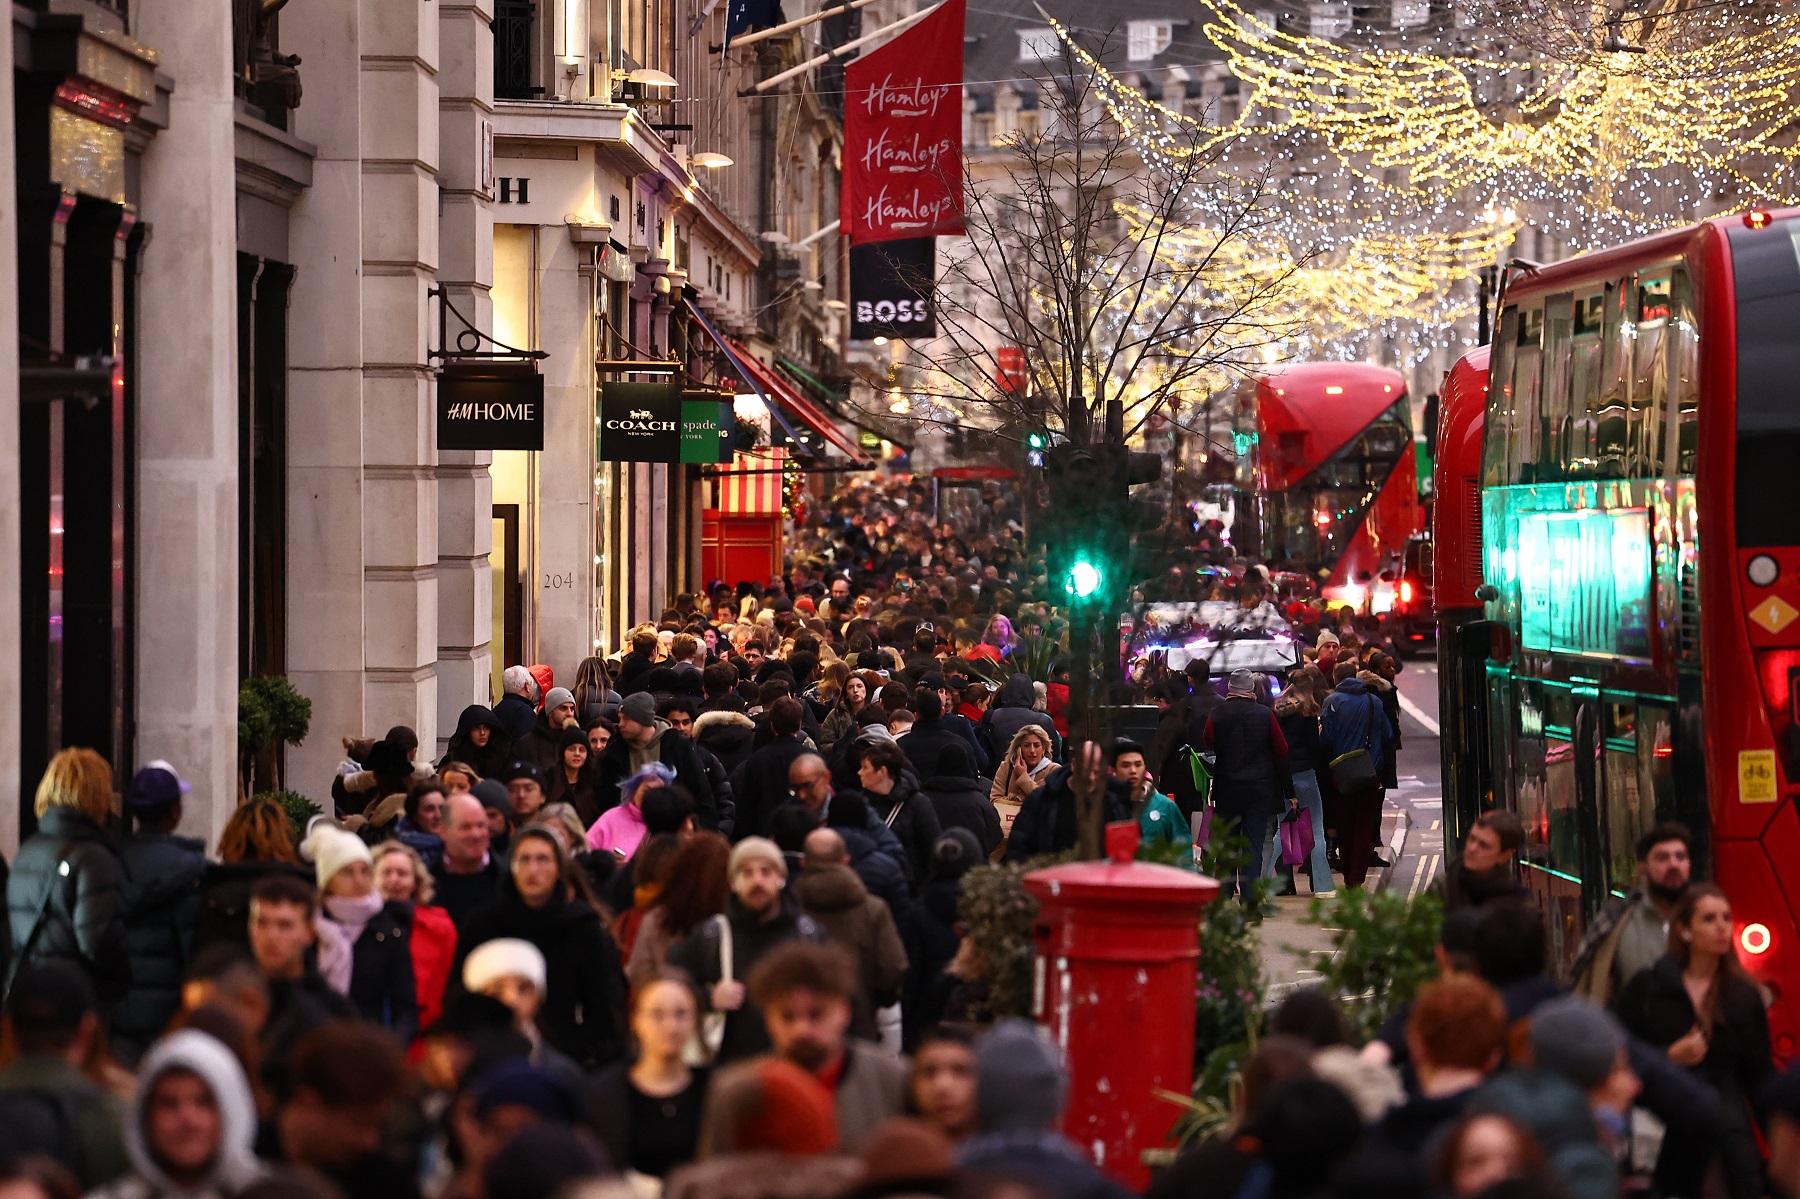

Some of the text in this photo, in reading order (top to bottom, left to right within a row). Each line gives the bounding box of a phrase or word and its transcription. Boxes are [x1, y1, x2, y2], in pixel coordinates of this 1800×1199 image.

[861, 73, 949, 117] Hamleys
[861, 128, 949, 171] Hamleys
[493, 177, 530, 203] H
[862, 184, 951, 230] Hamleys
[857, 299, 928, 323] BOSS
[474, 403, 535, 420] HOME
[606, 420, 676, 431] COACH
[683, 420, 716, 432] spade
[544, 571, 573, 589] 204
